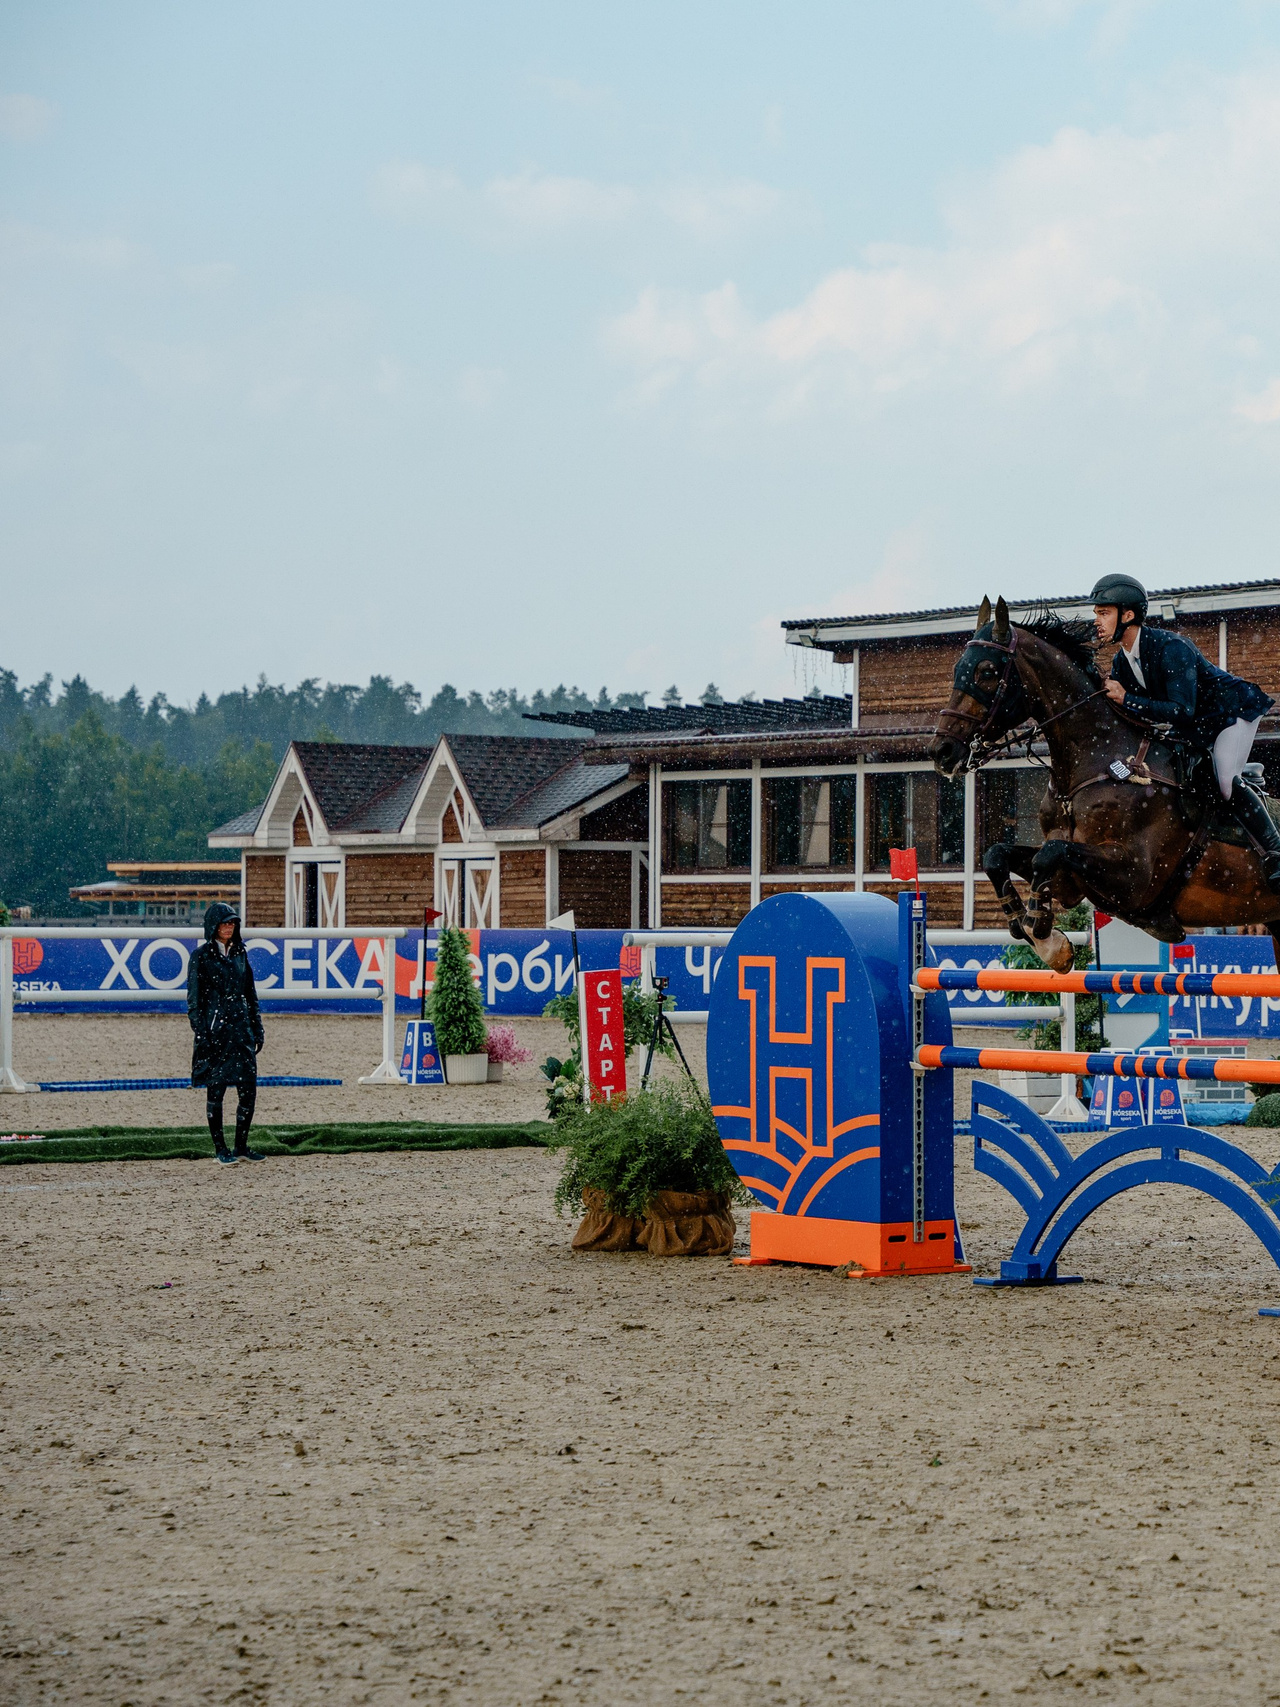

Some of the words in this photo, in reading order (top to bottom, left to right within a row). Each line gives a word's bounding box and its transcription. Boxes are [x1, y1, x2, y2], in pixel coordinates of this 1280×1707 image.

[99, 937, 385, 990] ХОСЕКА
[422, 1031, 433, 1047] B
[596, 980, 616, 1101] СТАРТ
